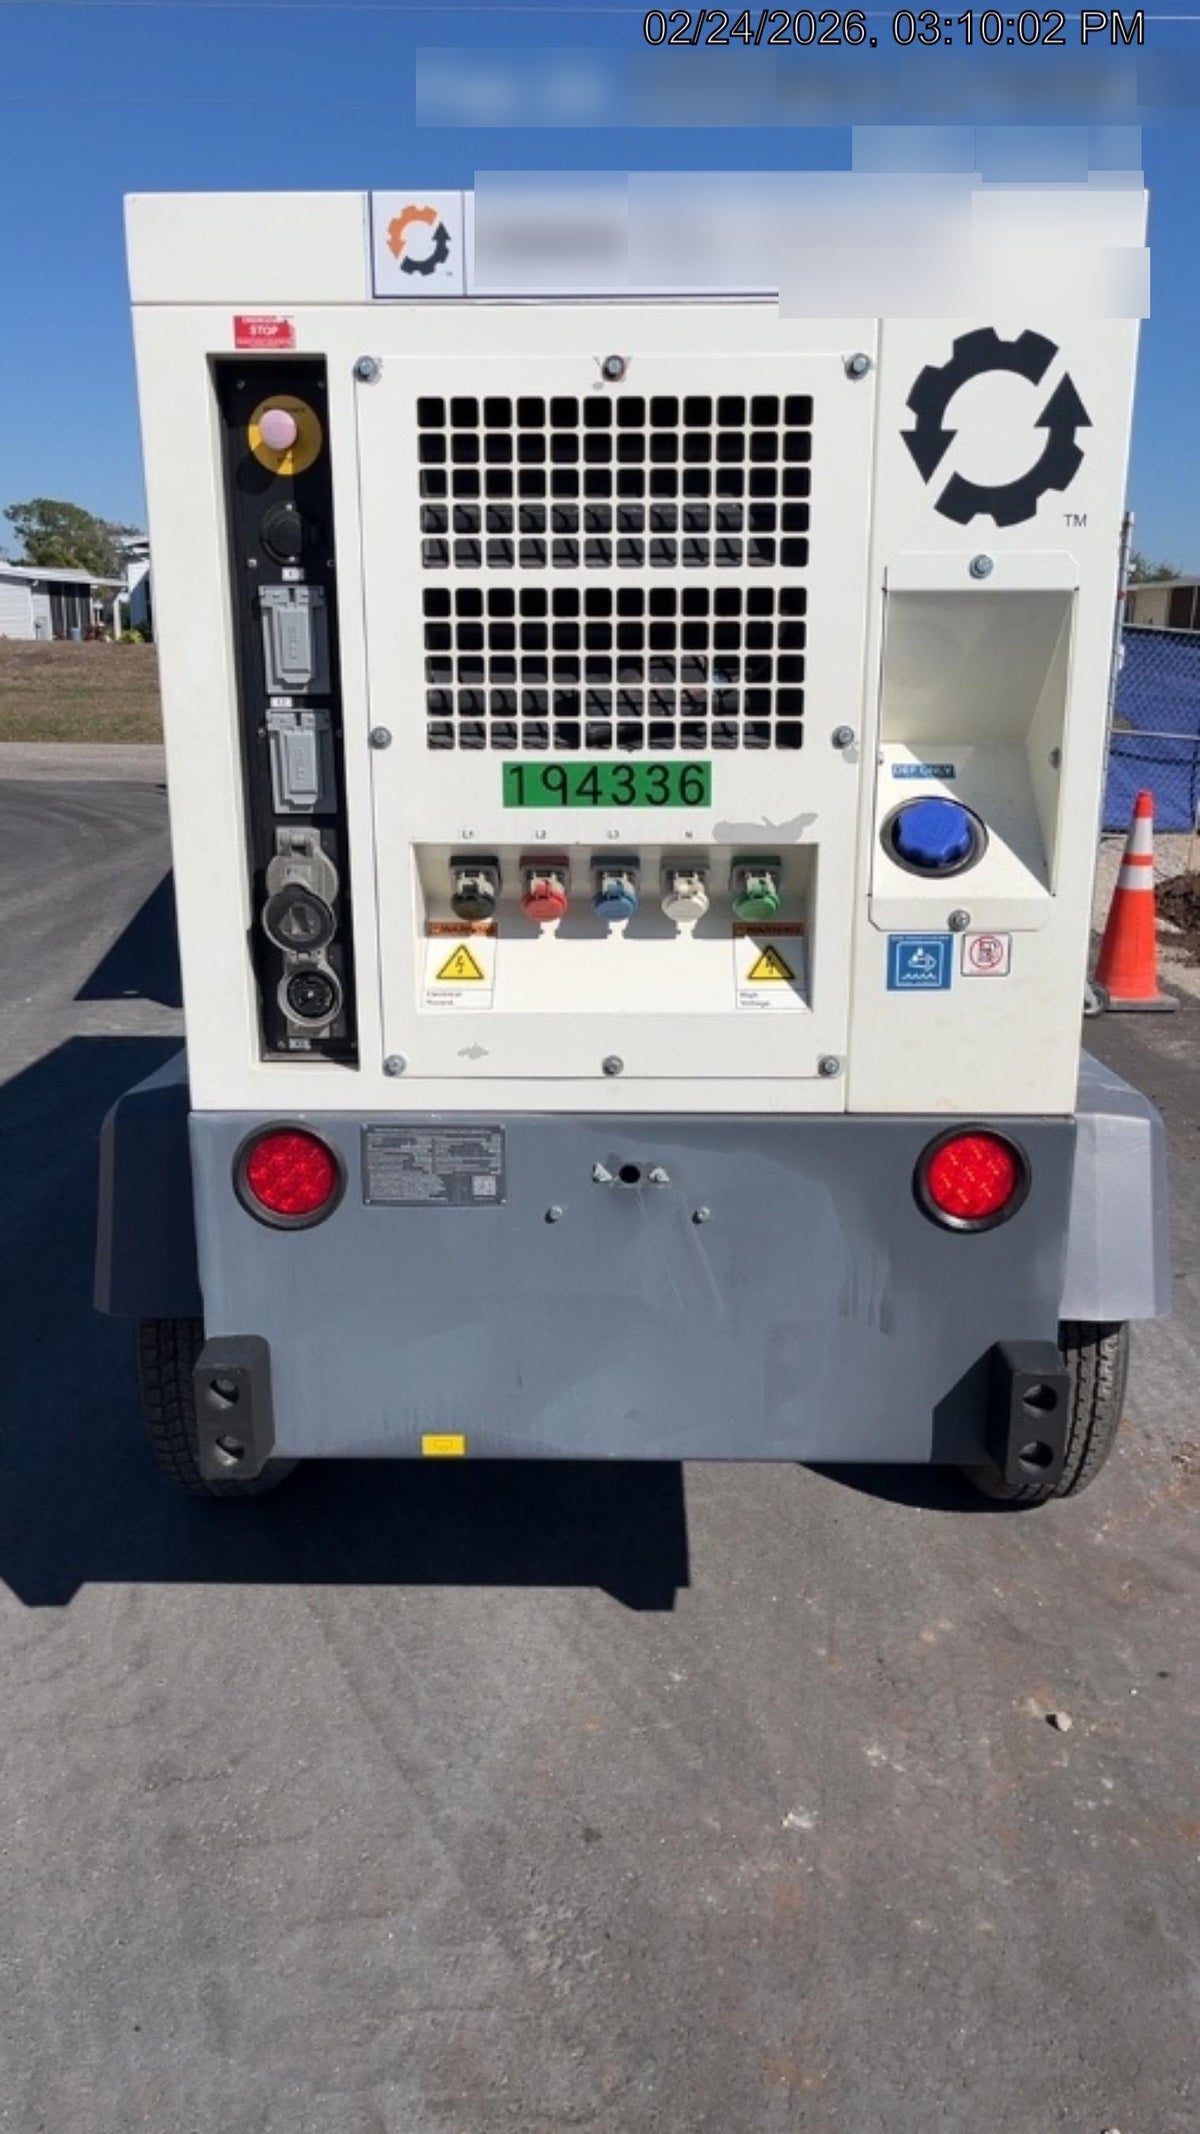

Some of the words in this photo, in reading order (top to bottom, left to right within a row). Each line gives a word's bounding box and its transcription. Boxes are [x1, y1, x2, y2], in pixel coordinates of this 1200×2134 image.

[248, 324, 279, 336] STOP
[1063, 513, 1087, 527] TM
[509, 764, 705, 806] 194336
